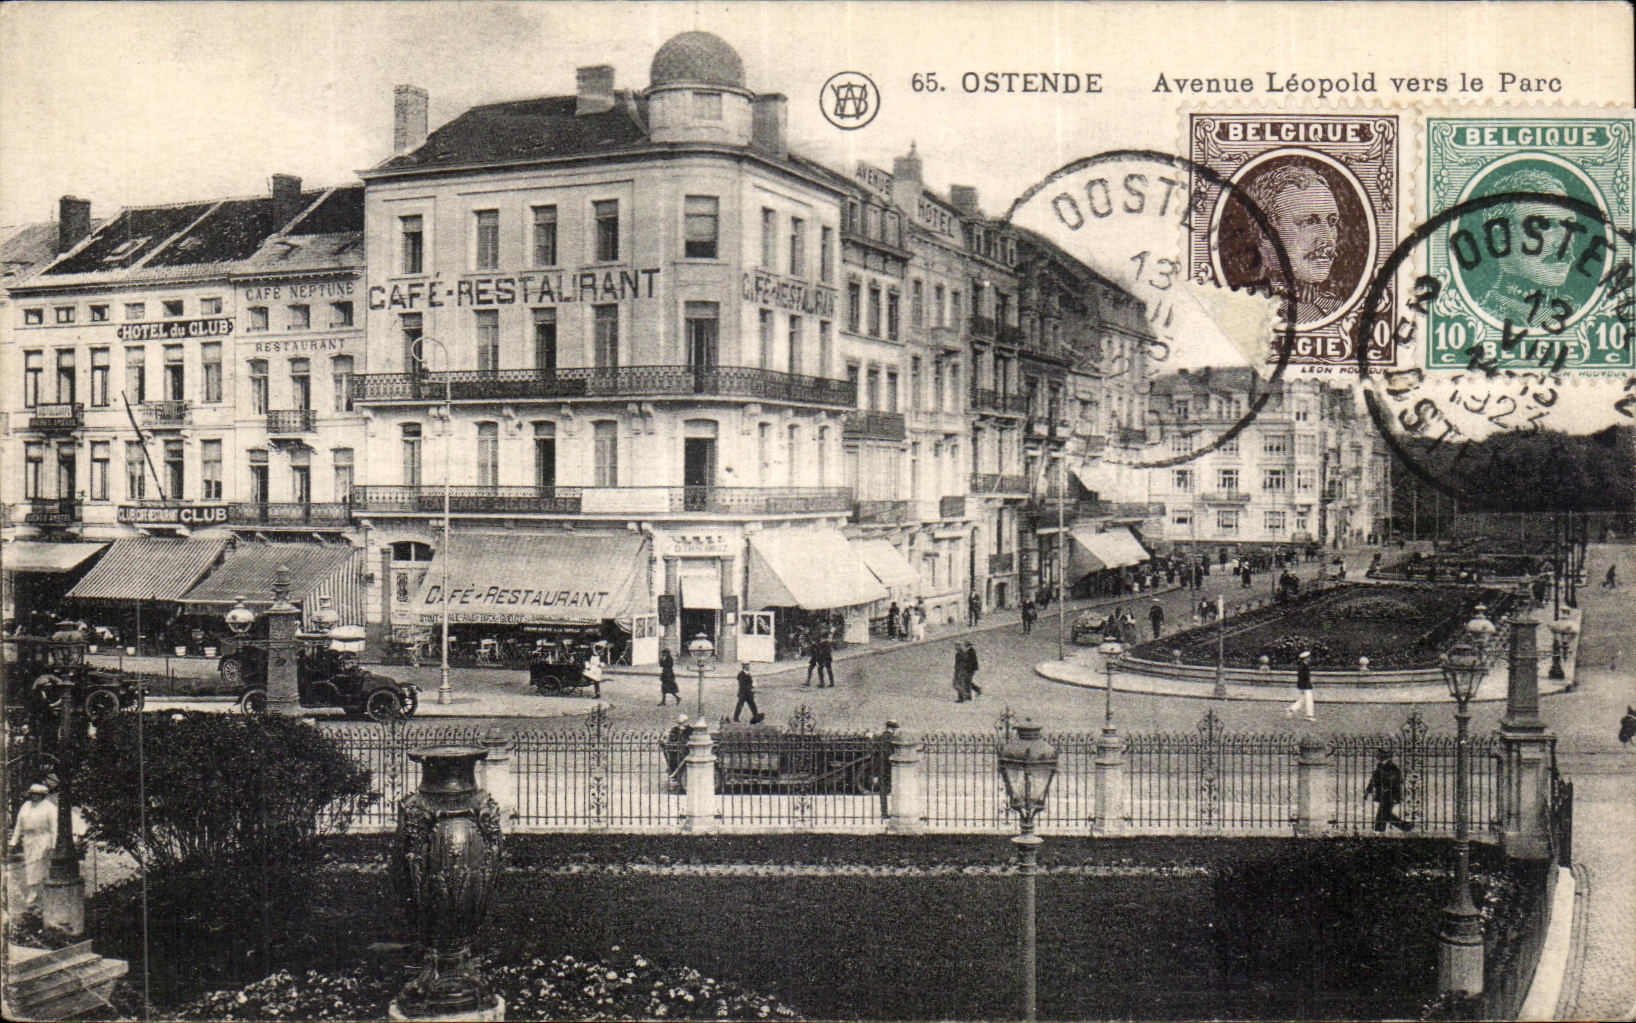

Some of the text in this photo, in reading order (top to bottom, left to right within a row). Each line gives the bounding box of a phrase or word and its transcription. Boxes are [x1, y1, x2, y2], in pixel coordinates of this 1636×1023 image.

[1228, 123, 1360, 142] BELGIQUE
[1465, 128, 1597, 146] BELGIQUE
[290, 282, 355, 298] NEPTUNE
[122, 320, 229, 340] HOTEL du CLUB
[1434, 321, 1467, 351] 10
[1595, 321, 1627, 351] 10
[256, 339, 345, 353] RESTAURANT
[180, 507, 228, 523] CLUB
